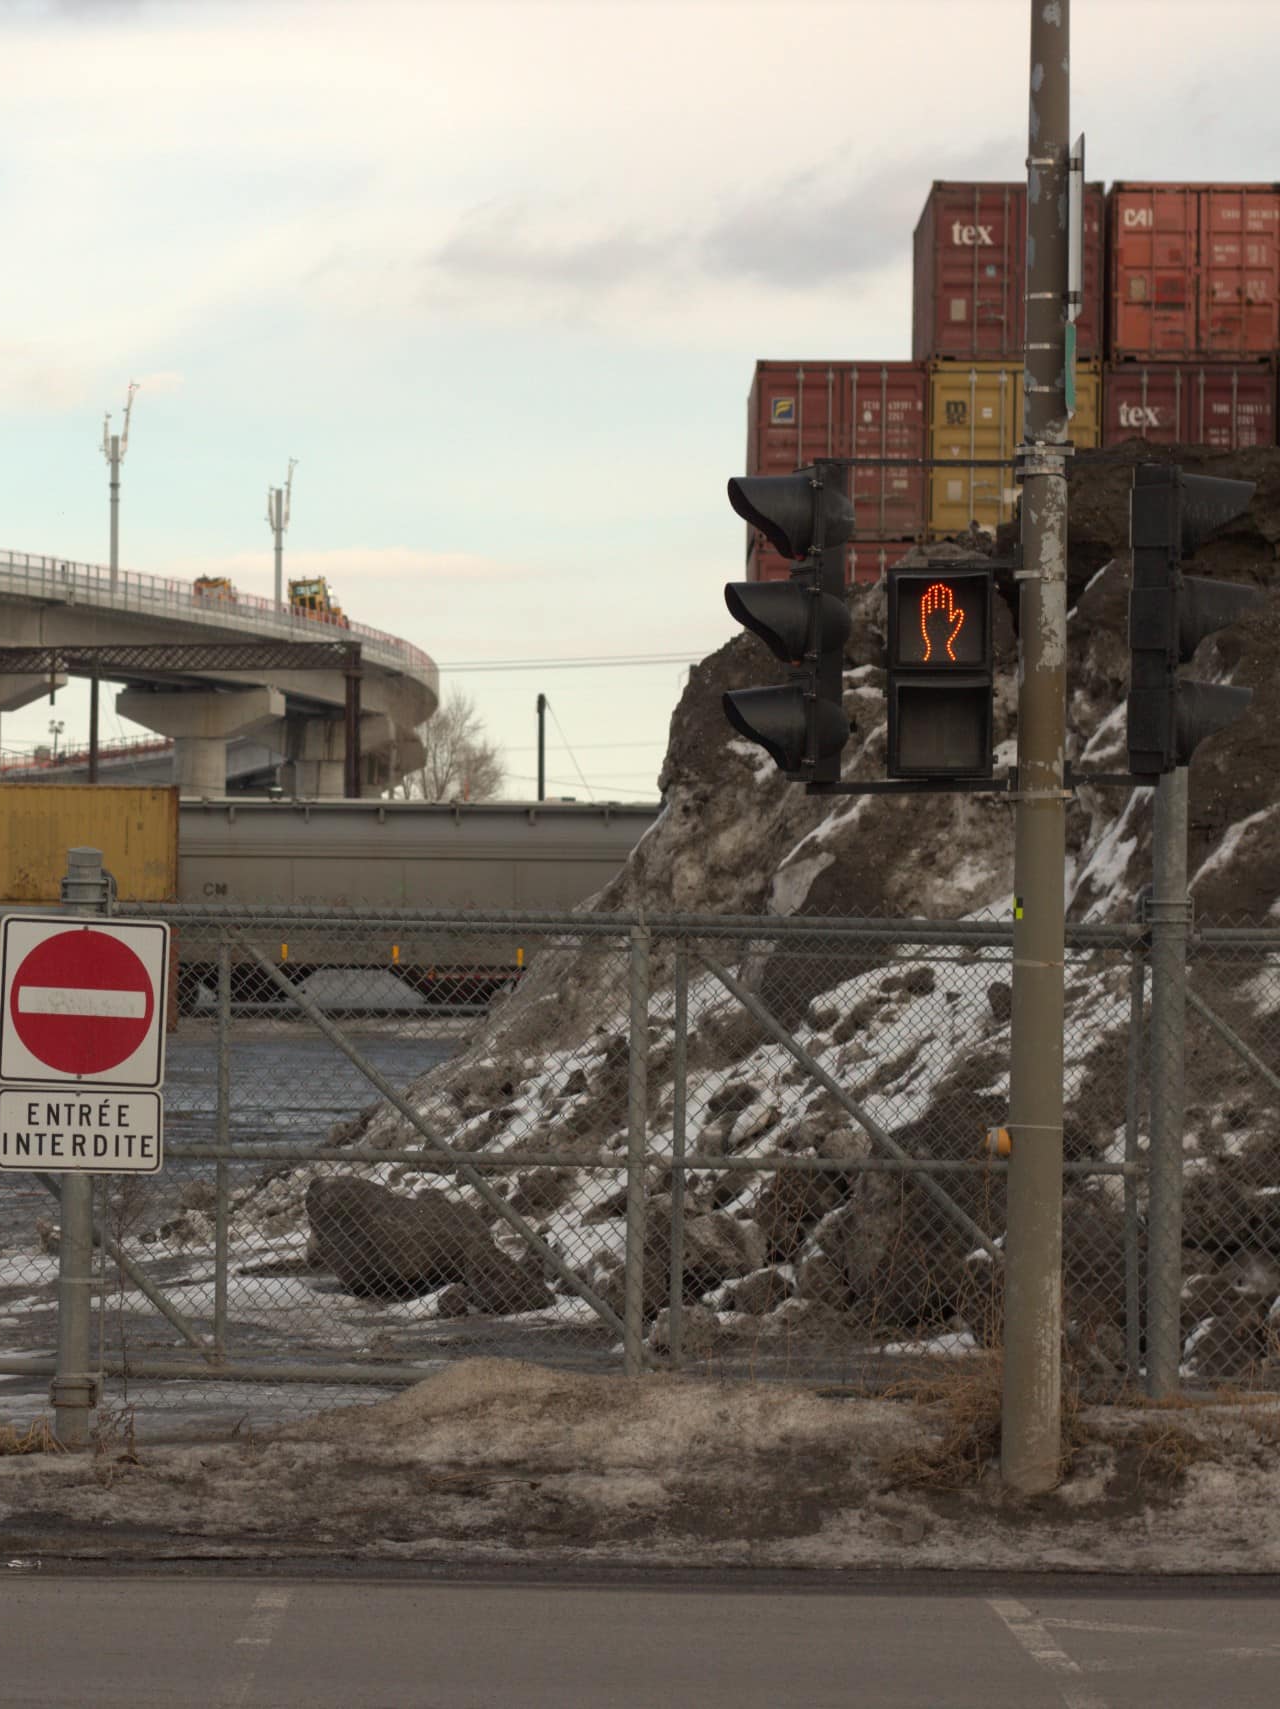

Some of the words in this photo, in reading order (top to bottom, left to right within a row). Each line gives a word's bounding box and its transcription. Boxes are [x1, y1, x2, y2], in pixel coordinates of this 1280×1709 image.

[1123, 208, 1153, 227] CAI
[951, 220, 993, 246] tex
[1118, 401, 1160, 428] tex
[27, 1099, 130, 1127] ENTRÉE
[3, 1133, 154, 1158] INTERDITE
